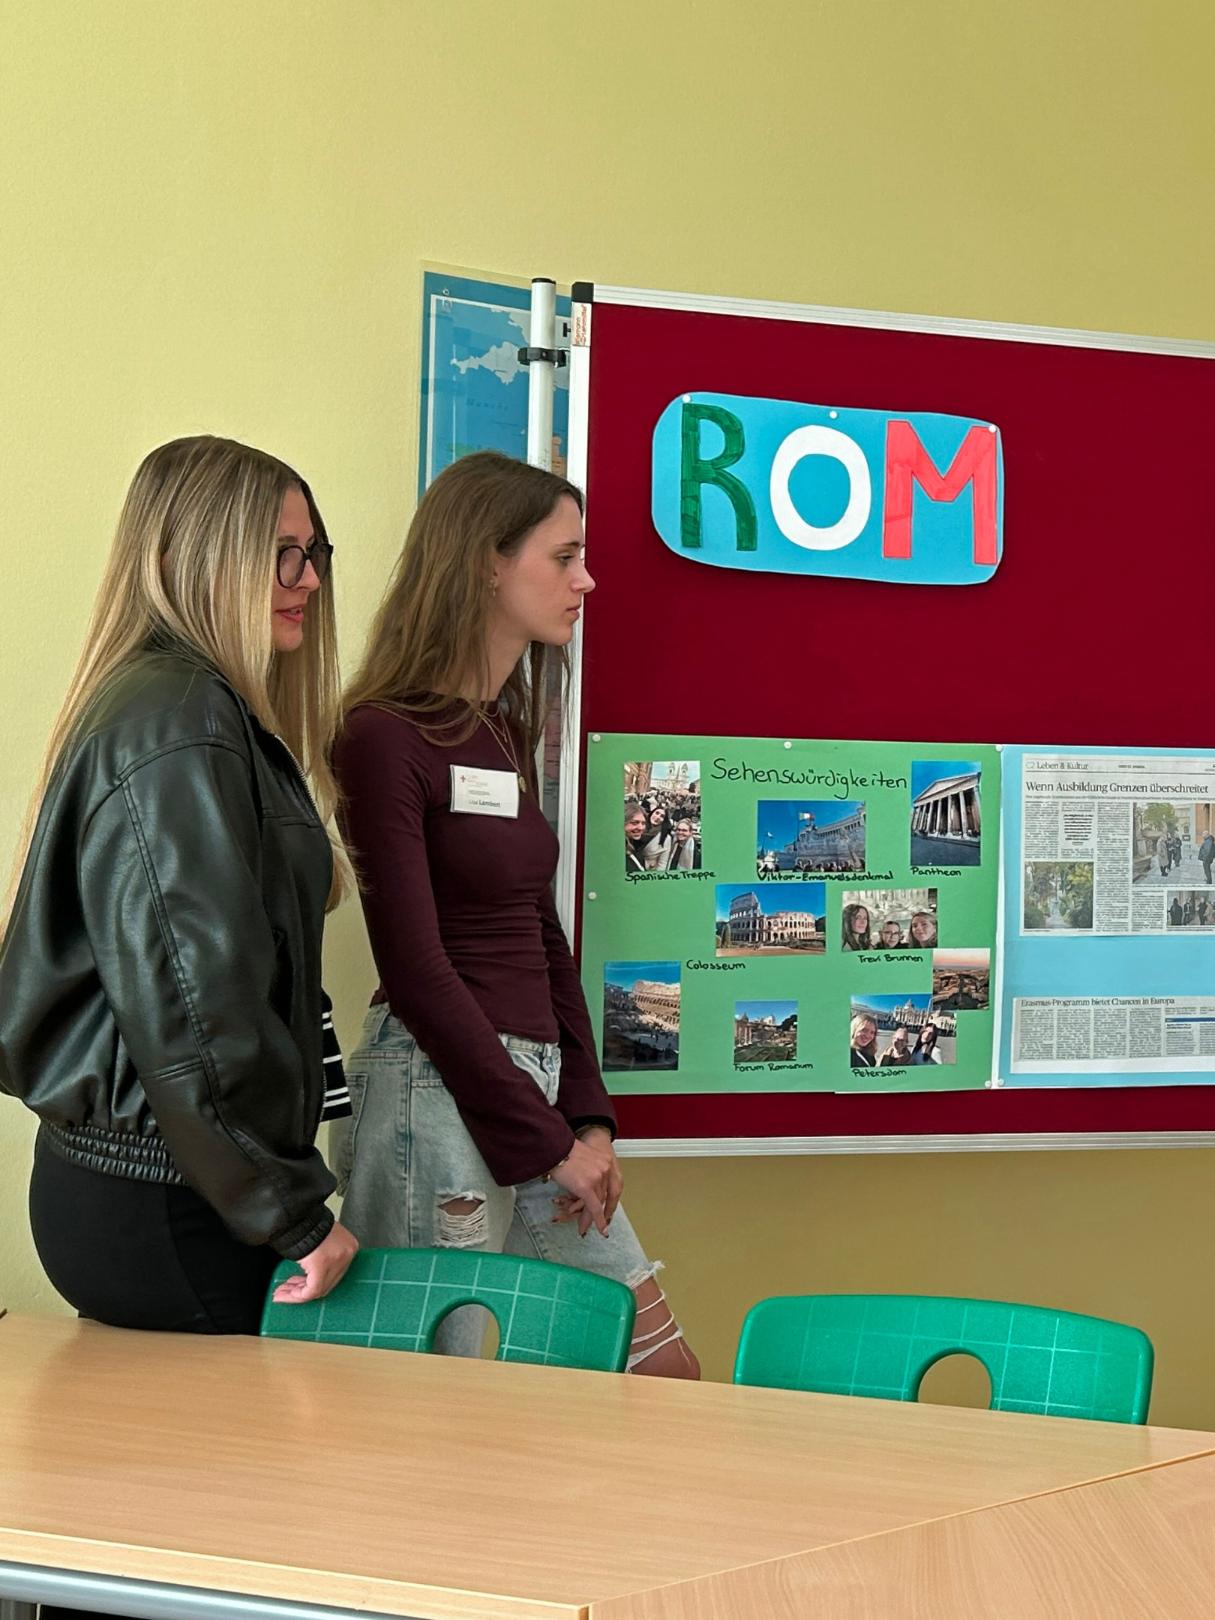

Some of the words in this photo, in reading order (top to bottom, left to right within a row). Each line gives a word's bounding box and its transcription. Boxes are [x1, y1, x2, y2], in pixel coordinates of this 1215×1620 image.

[681, 402, 997, 566] ROM
[710, 758, 908, 800] Sehenswürdigkeiten
[1026, 781, 1054, 792] Wenn
[1056, 782, 1108, 794] Ausbildung
[1110, 782, 1148, 793] Grenzen
[1150, 784, 1209, 794] überschreitet
[625, 871, 680, 885] Spanische
[680, 870, 716, 881] Treppe
[912, 866, 962, 877] Pantheon
[884, 954, 924, 963] Brunnen
[686, 959, 746, 971] Colosseum
[734, 1064, 764, 1072] Forum
[768, 1063, 814, 1072] Romanum
[852, 1069, 907, 1078] Petersdom
